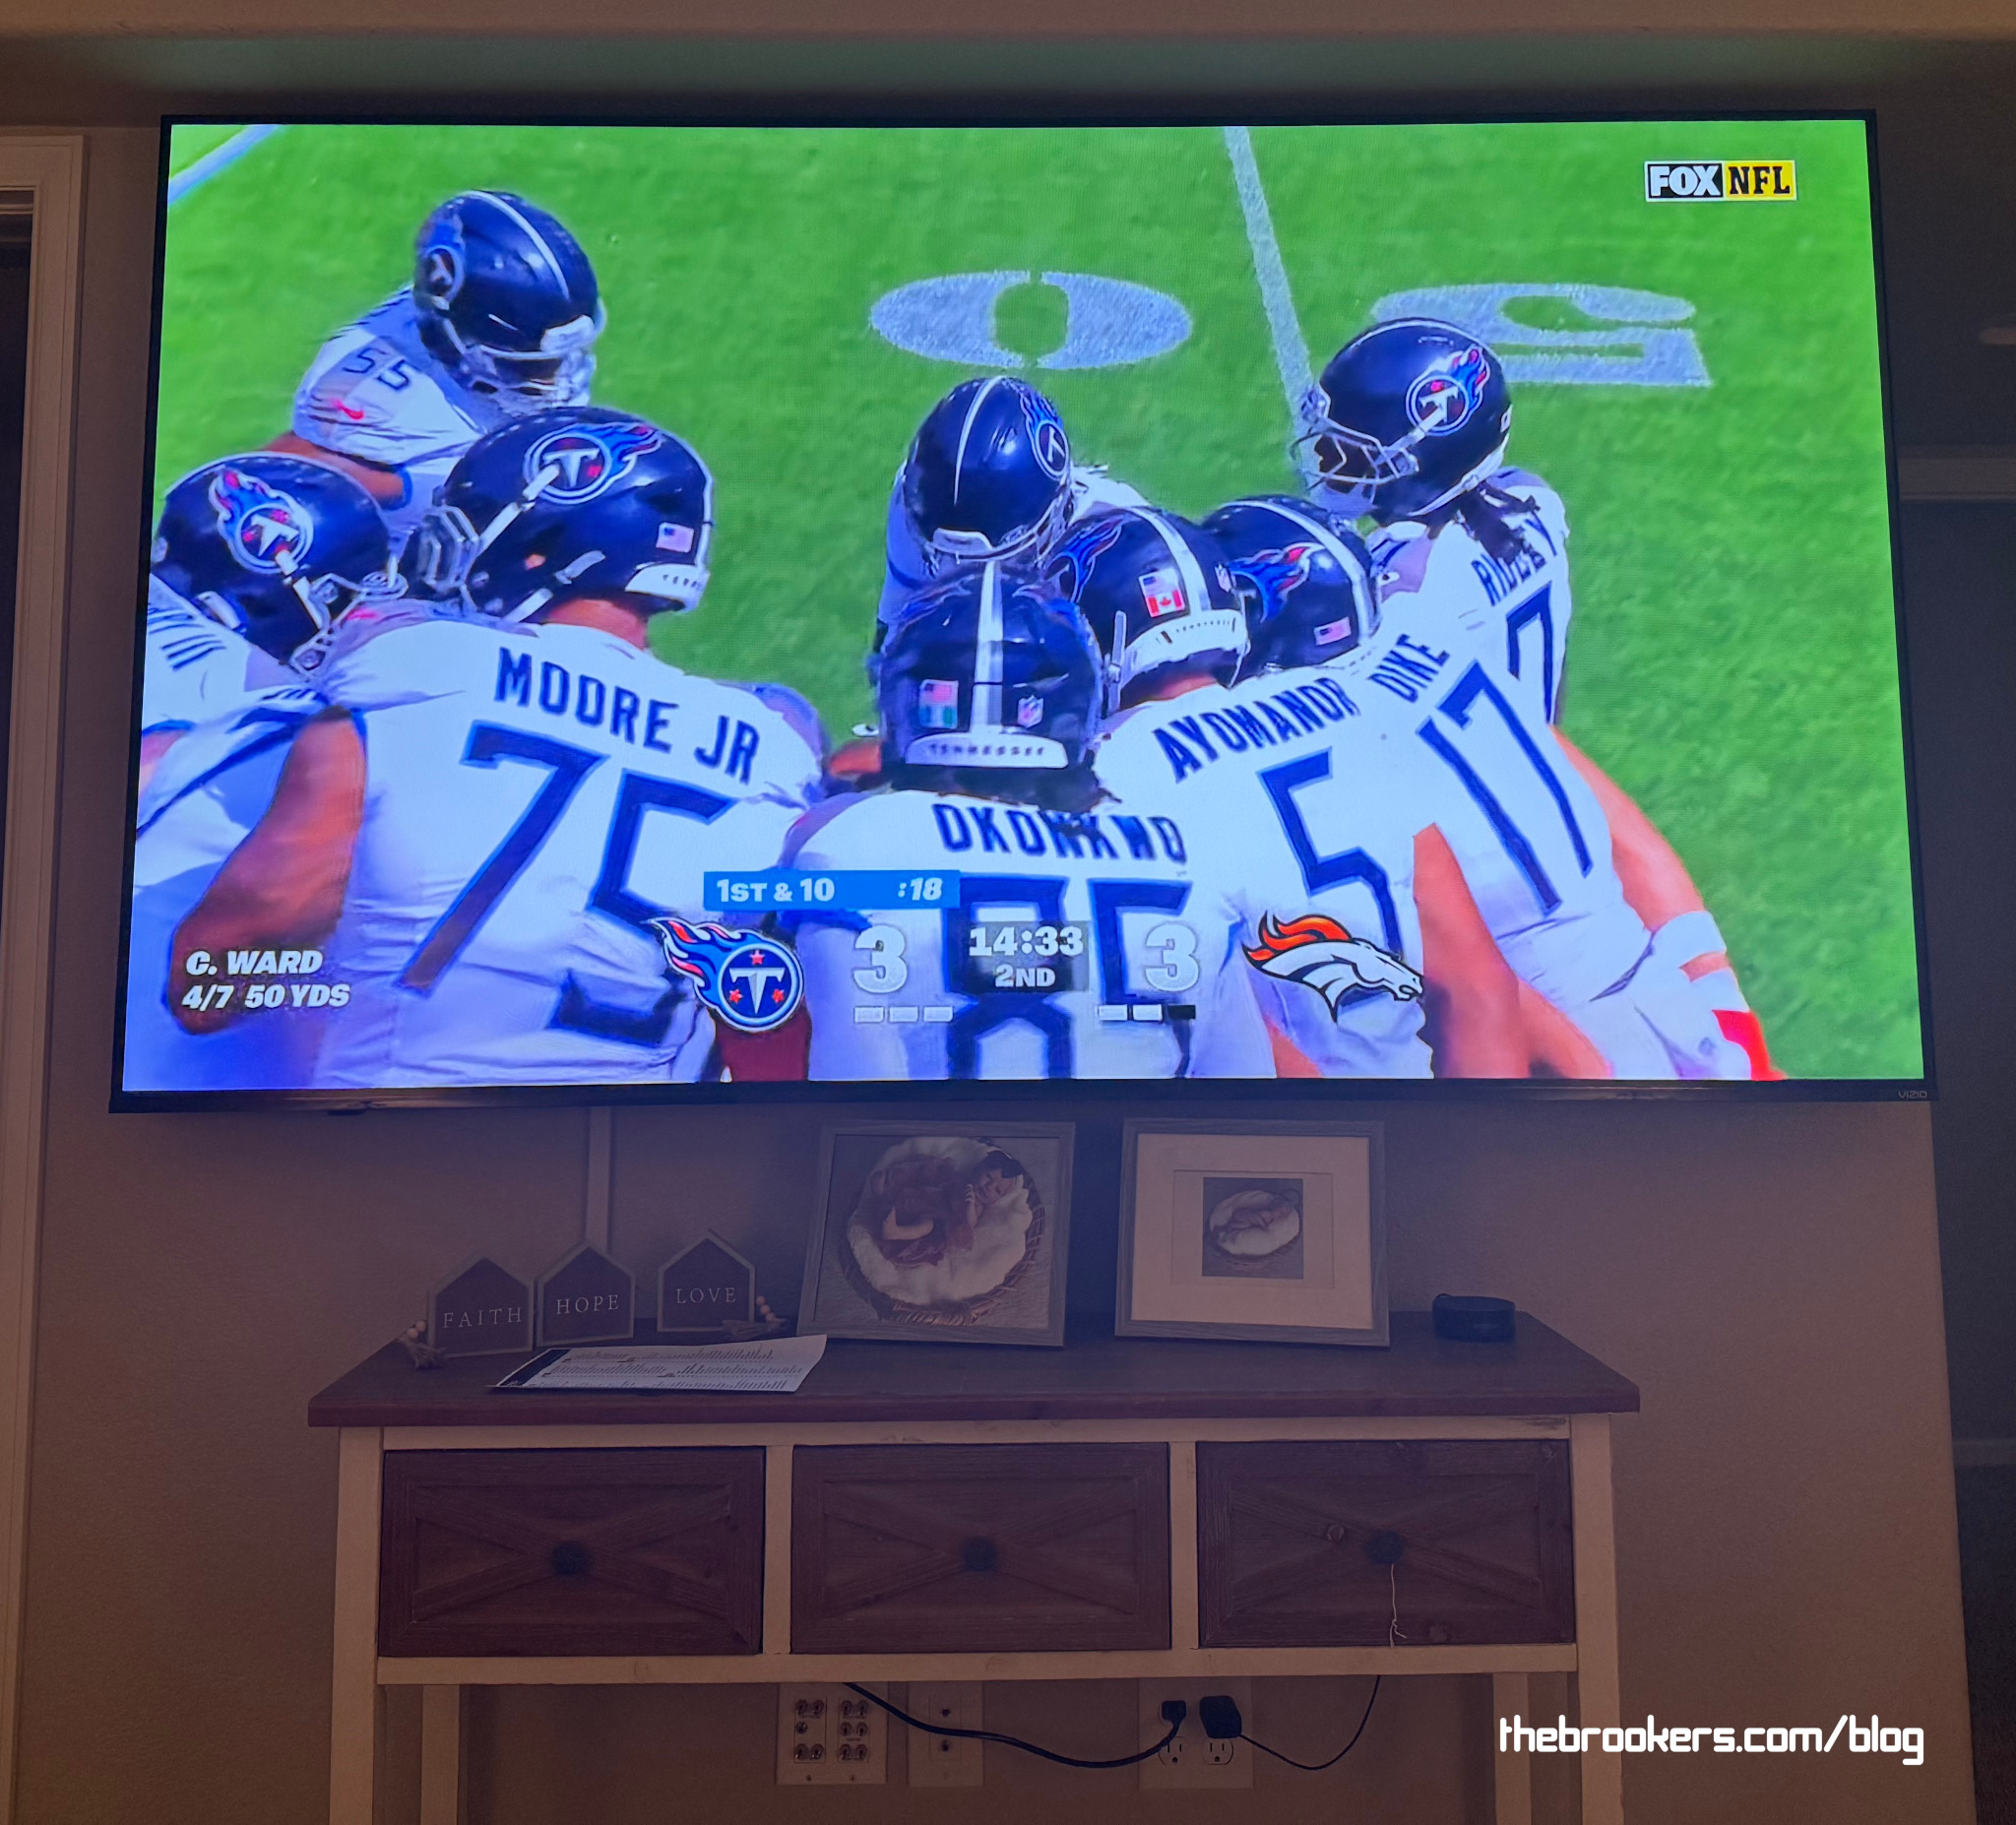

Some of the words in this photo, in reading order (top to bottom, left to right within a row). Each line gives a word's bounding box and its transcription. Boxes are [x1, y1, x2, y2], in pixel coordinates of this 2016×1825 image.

[1649, 164, 1722, 197] FOX
[1728, 165, 1791, 195] NFL
[1369, 633, 1451, 704] DIKE
[494, 647, 679, 754] MOORE
[694, 714, 760, 784] JR
[1415, 658, 1594, 916] 17
[1258, 746, 1408, 969] 5
[397, 720, 737, 1047] 75
[717, 877, 768, 903] 1ST
[773, 883, 793, 902] &
[799, 876, 836, 903] 10
[968, 925, 1084, 958] 14:33
[1144, 922, 1200, 992] 3
[226, 950, 324, 975] WARD
[852, 924, 909, 994] 3
[993, 963, 1056, 988] 2ND
[181, 984, 235, 1012] 4/7
[244, 984, 286, 1010] 50
[290, 982, 352, 1009] YDS
[1898, 1090, 1928, 1100] VIZIO
[555, 1293, 620, 1315] HOPE
[675, 1287, 736, 1304] LOVE
[443, 1306, 523, 1329] FAITH
